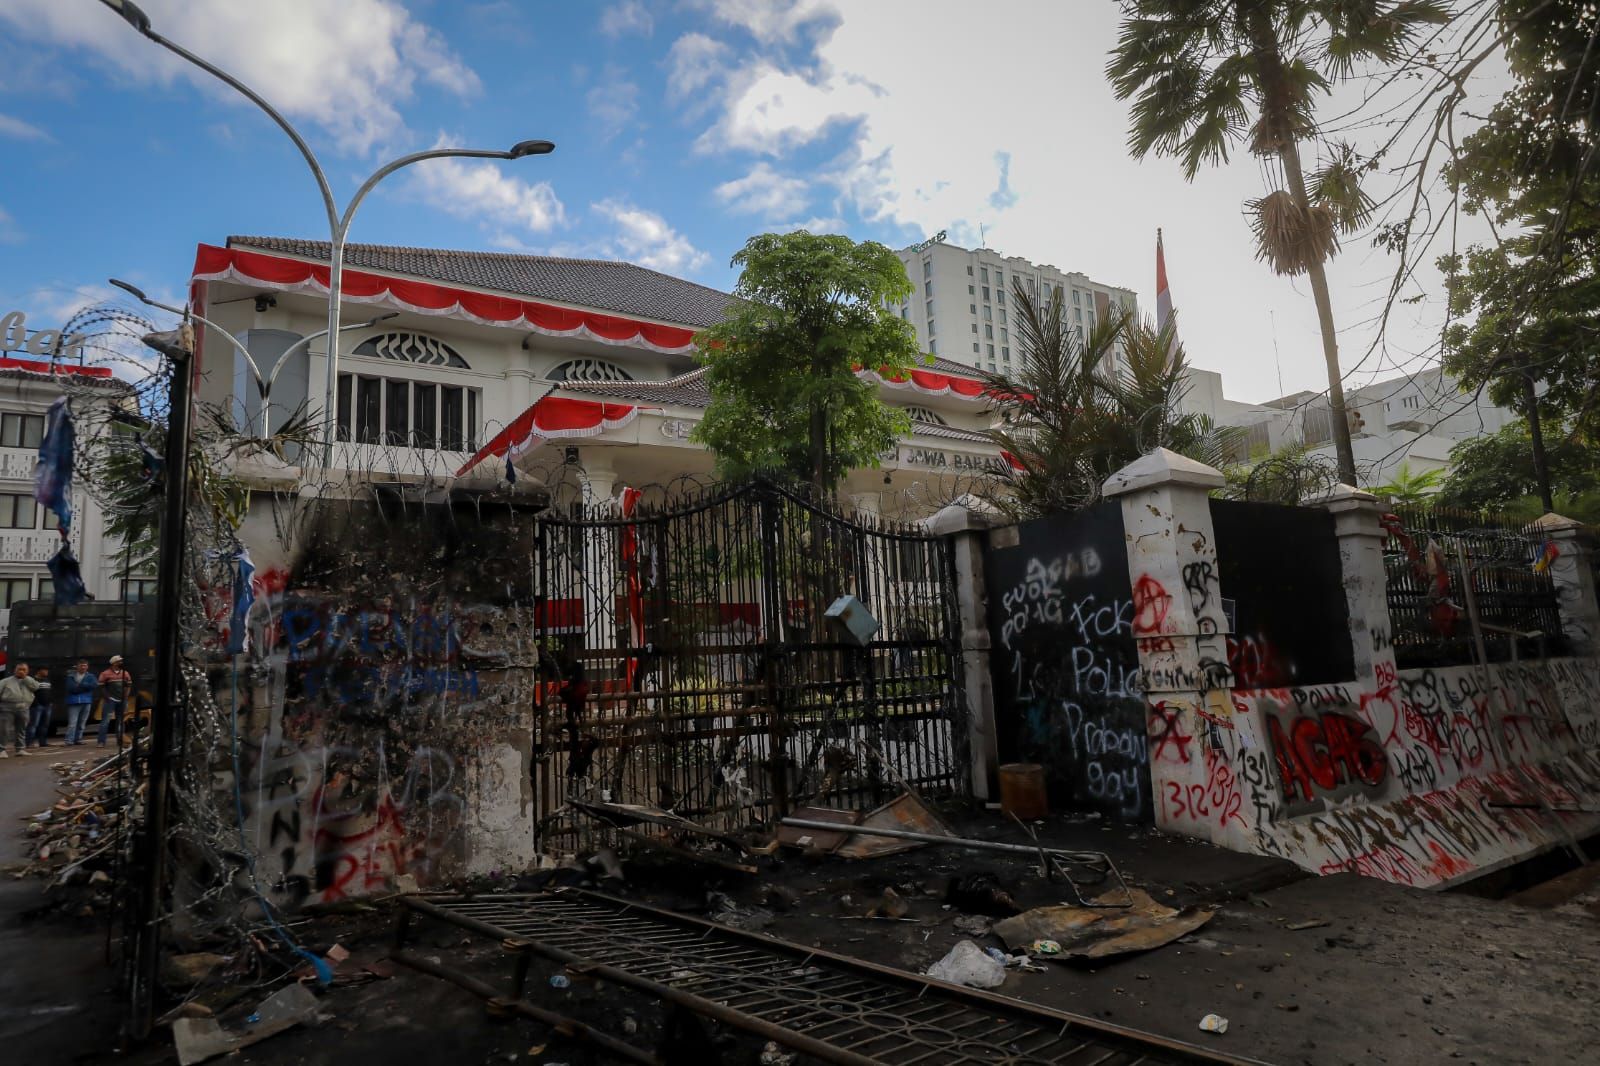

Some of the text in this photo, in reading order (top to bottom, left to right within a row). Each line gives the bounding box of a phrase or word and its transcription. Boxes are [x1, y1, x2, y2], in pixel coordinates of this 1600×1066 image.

[906, 448, 947, 467] JAWA
[1265, 712, 1389, 802] ACAB
[1159, 778, 1209, 825] 1312
